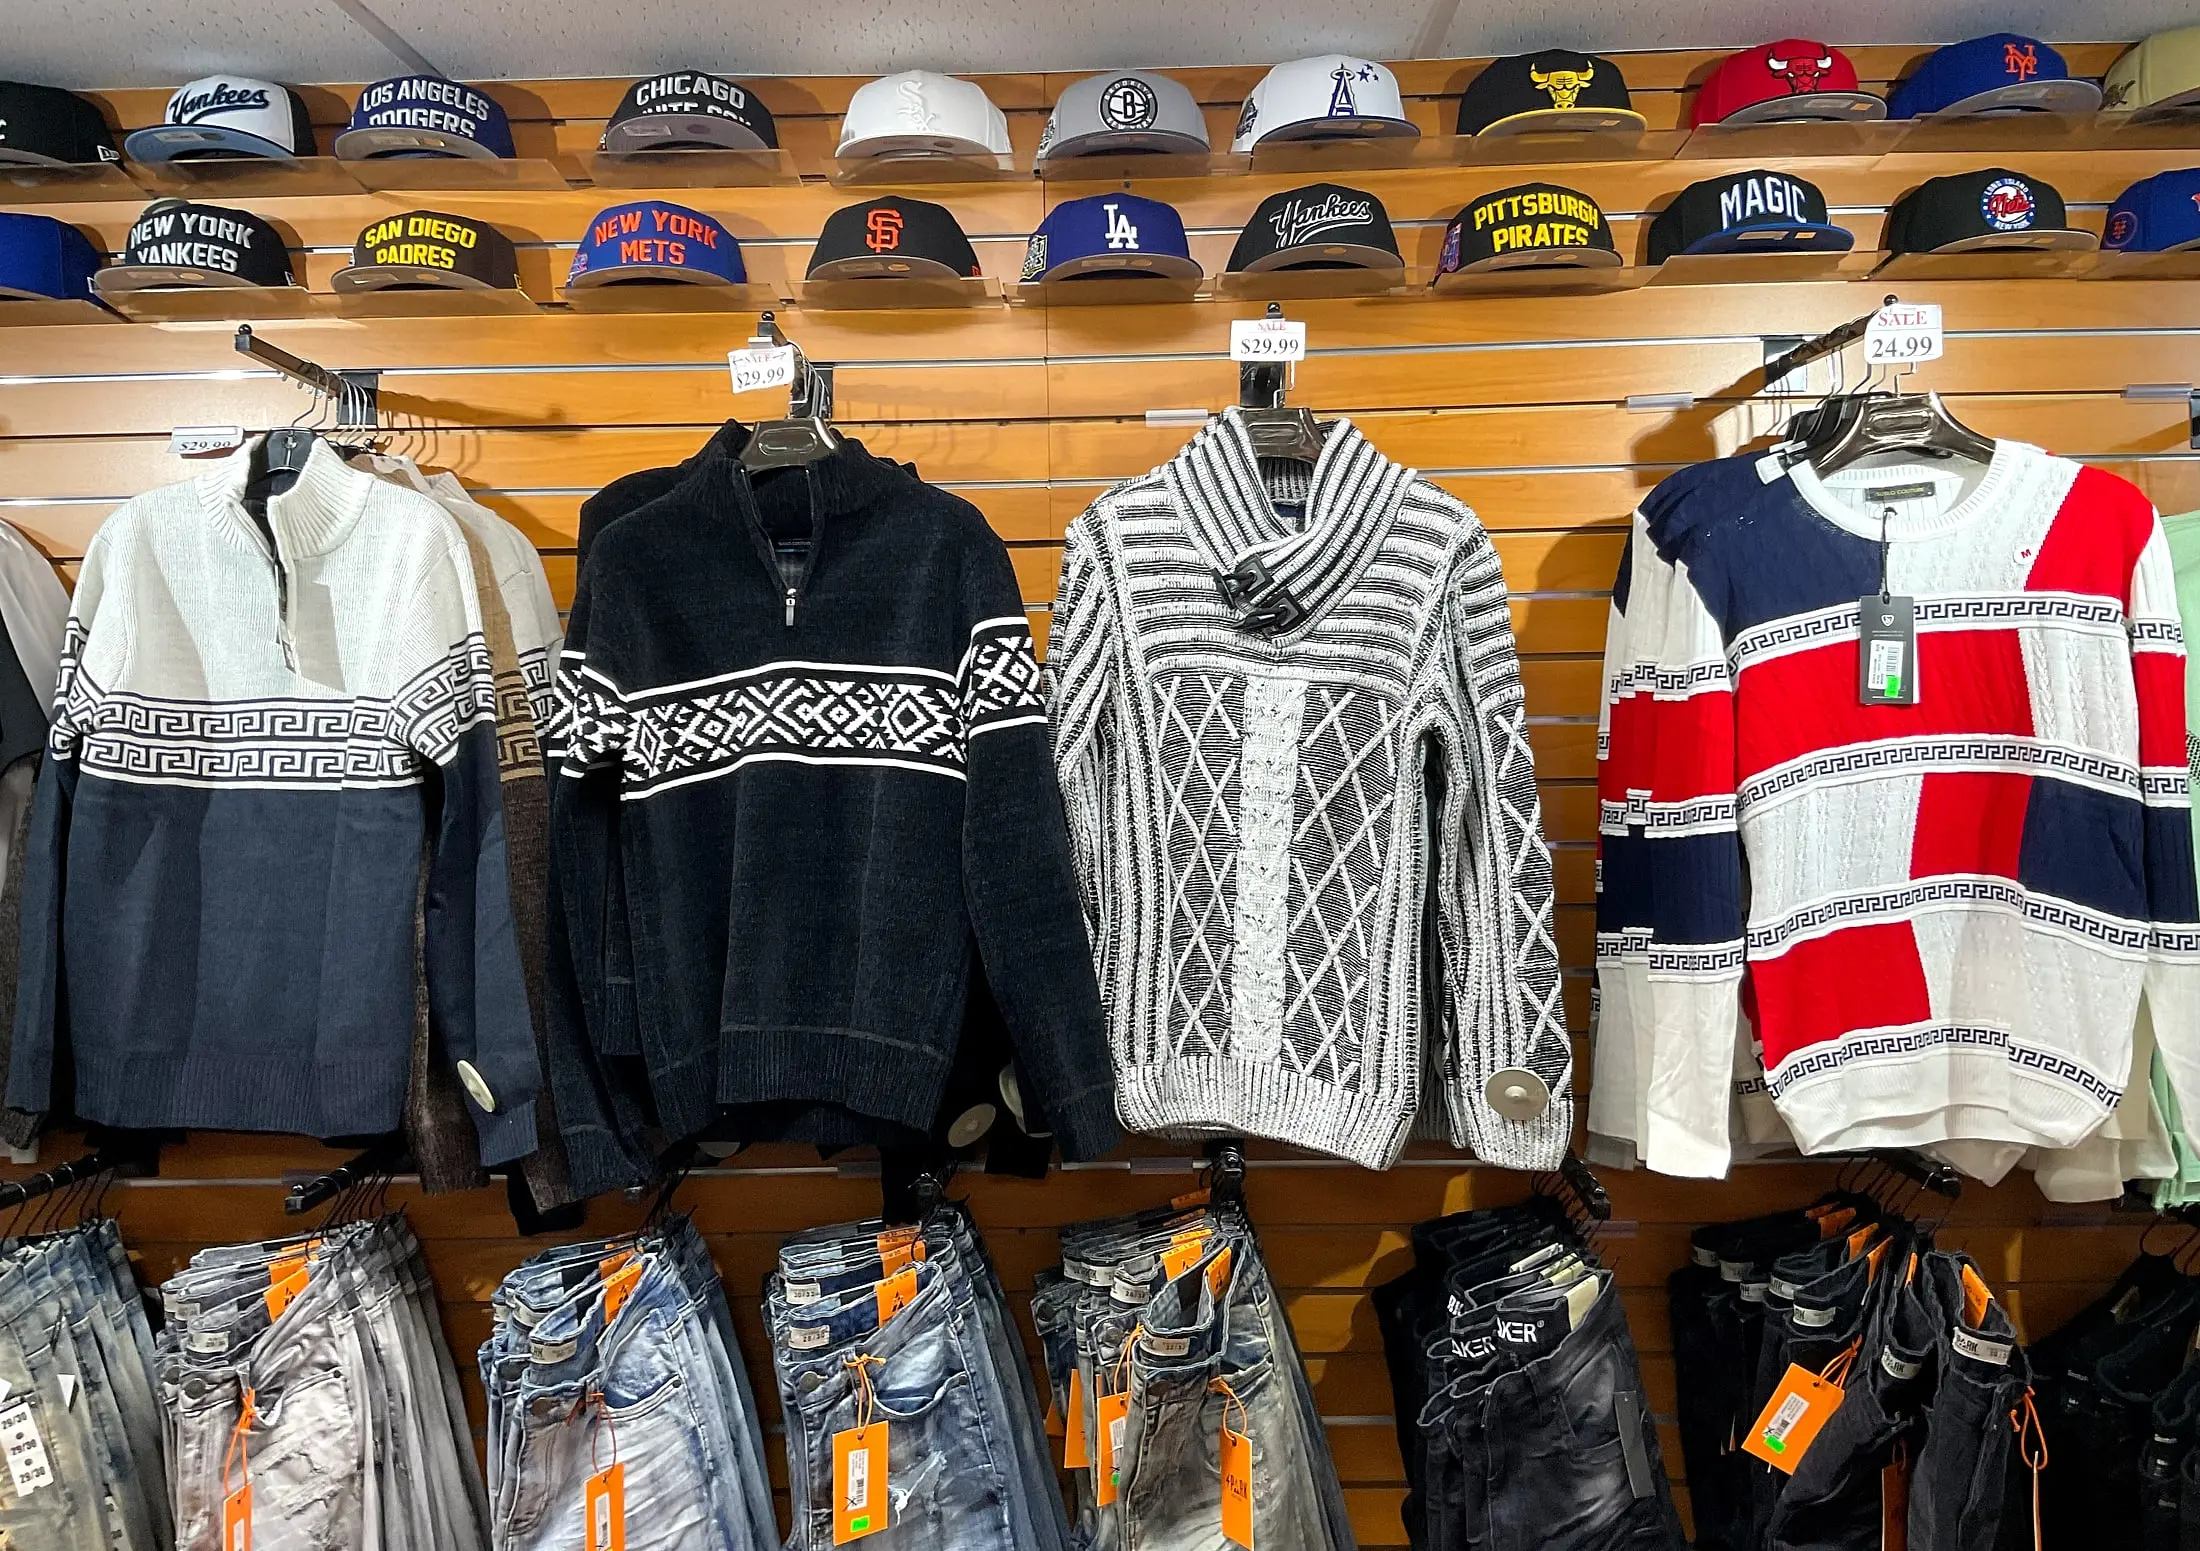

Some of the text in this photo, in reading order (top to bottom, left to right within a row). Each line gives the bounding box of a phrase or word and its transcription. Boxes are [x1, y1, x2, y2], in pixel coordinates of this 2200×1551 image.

[168, 82, 270, 125] Yankees
[363, 79, 490, 121] LOS ANGELES
[636, 74, 745, 110] CHICAGO
[1269, 193, 1373, 249] Yankees
[1473, 192, 1599, 231] PITTSBURGH
[1720, 176, 1807, 231] MAGIC
[130, 212, 255, 250] NEW YORK
[365, 216, 478, 250] SAN DIEGO
[594, 209, 719, 250] NEW YORK
[866, 207, 905, 254] SF
[1103, 203, 1140, 250] LA
[1492, 222, 1589, 253] PIRATES
[136, 241, 239, 274] YANKEES
[375, 242, 457, 270] PADRES
[620, 238, 687, 265] METS
[1878, 310, 1927, 327] SALE
[1240, 338, 1299, 355] $29.99
[1871, 336, 1932, 358] 24.99
[736, 366, 785, 389] $29.99
[2020, 548, 2032, 559] M
